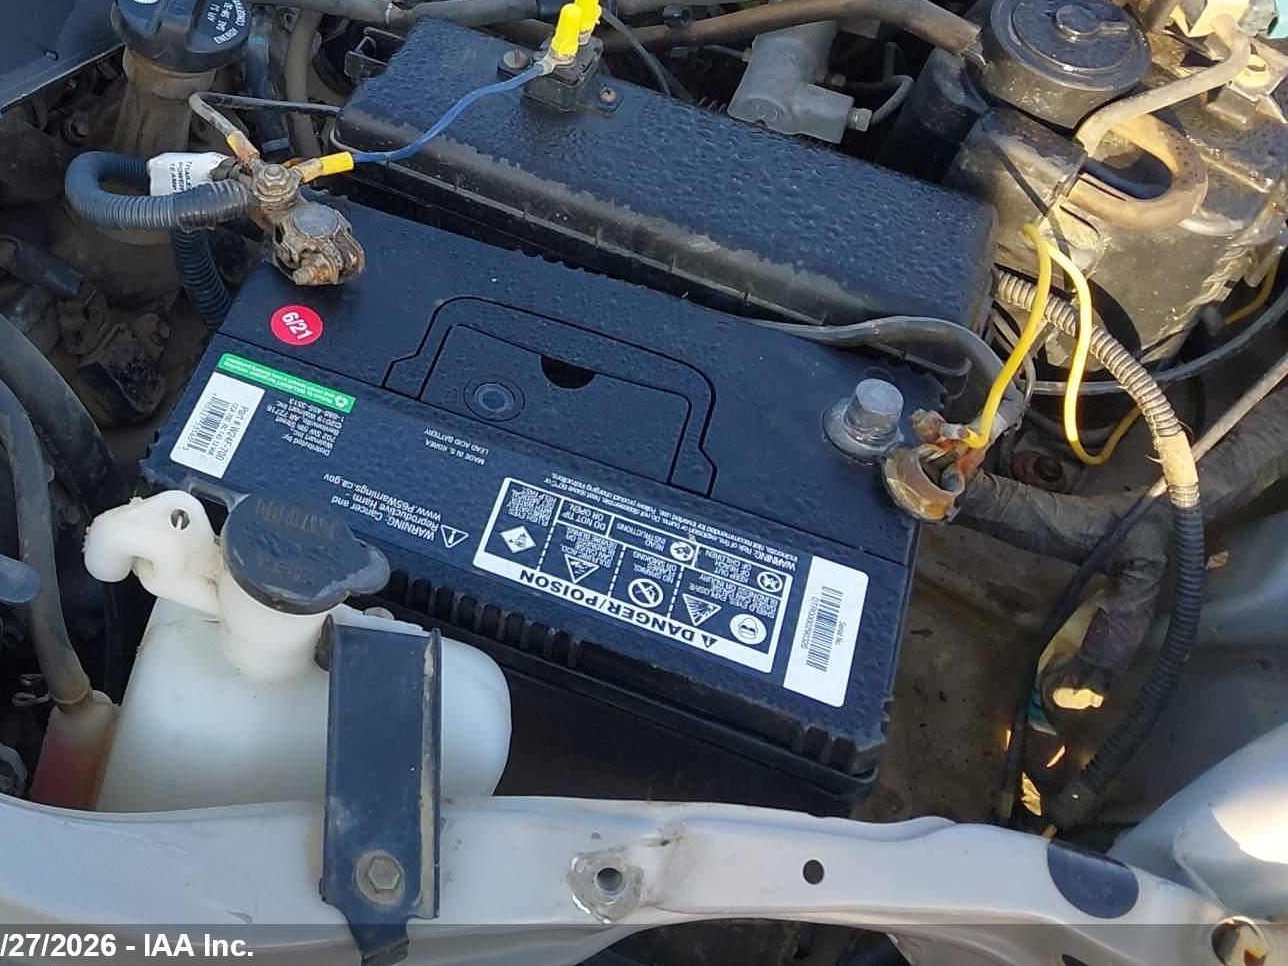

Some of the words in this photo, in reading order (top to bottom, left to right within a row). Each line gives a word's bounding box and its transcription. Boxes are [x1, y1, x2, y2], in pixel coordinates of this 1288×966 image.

[213, 27, 239, 44] ENERGY
[184, 160, 193, 190] TRAILE
[282, 309, 312, 342] 6/21
[235, 405, 249, 420] Part
[265, 404, 289, 417] 72716
[287, 404, 317, 420] Walmart
[288, 412, 300, 421] AR
[274, 415, 296, 428] Street
[308, 428, 321, 437] SW
[321, 432, 336, 442] 702
[422, 427, 454, 443] BATTERY
[214, 424, 240, 462] W24F-700
[292, 438, 330, 456] Distributed
[303, 433, 334, 449] Walmart
[423, 438, 448, 452] KOREA
[453, 437, 471, 449] ACID
[455, 449, 464, 457] IN
[469, 443, 489, 455] LEAD
[463, 452, 485, 465] MADE
[322, 471, 442, 521] www.P65Warnings.ca.gov
[330, 495, 350, 508] and
[350, 493, 377, 509] Harm
[586, 491, 600, 501] heat
[349, 501, 383, 520] Cancer
[561, 509, 575, 520] TIP
[635, 502, 656, 514] Follow
[377, 501, 439, 531] Reproductive
[576, 514, 593, 525] NOT
[591, 511, 604, 521] OR
[383, 514, 436, 540] WARNING:
[592, 520, 606, 530] DO
[615, 521, 666, 544] INSTRUCTIONS
[688, 526, 717, 541] explosion
[644, 539, 664, 551] READ
[737, 544, 752, 554] Risk
[632, 550, 665, 566] SMOKING
[704, 549, 740, 566] CHILDREN
[752, 549, 796, 570] WARNING:
[665, 562, 677, 571] OR
[713, 566, 729, 576] OUT
[714, 559, 739, 572] REACH
[661, 574, 674, 583] NO
[698, 573, 724, 587] INJURY
[729, 572, 748, 583] KEEP
[688, 582, 727, 601] EXPLOSIVE
[518, 569, 695, 642] DANGER/POISON
[748, 602, 775, 618] SHIELD
[836, 620, 845, 637] Serial
